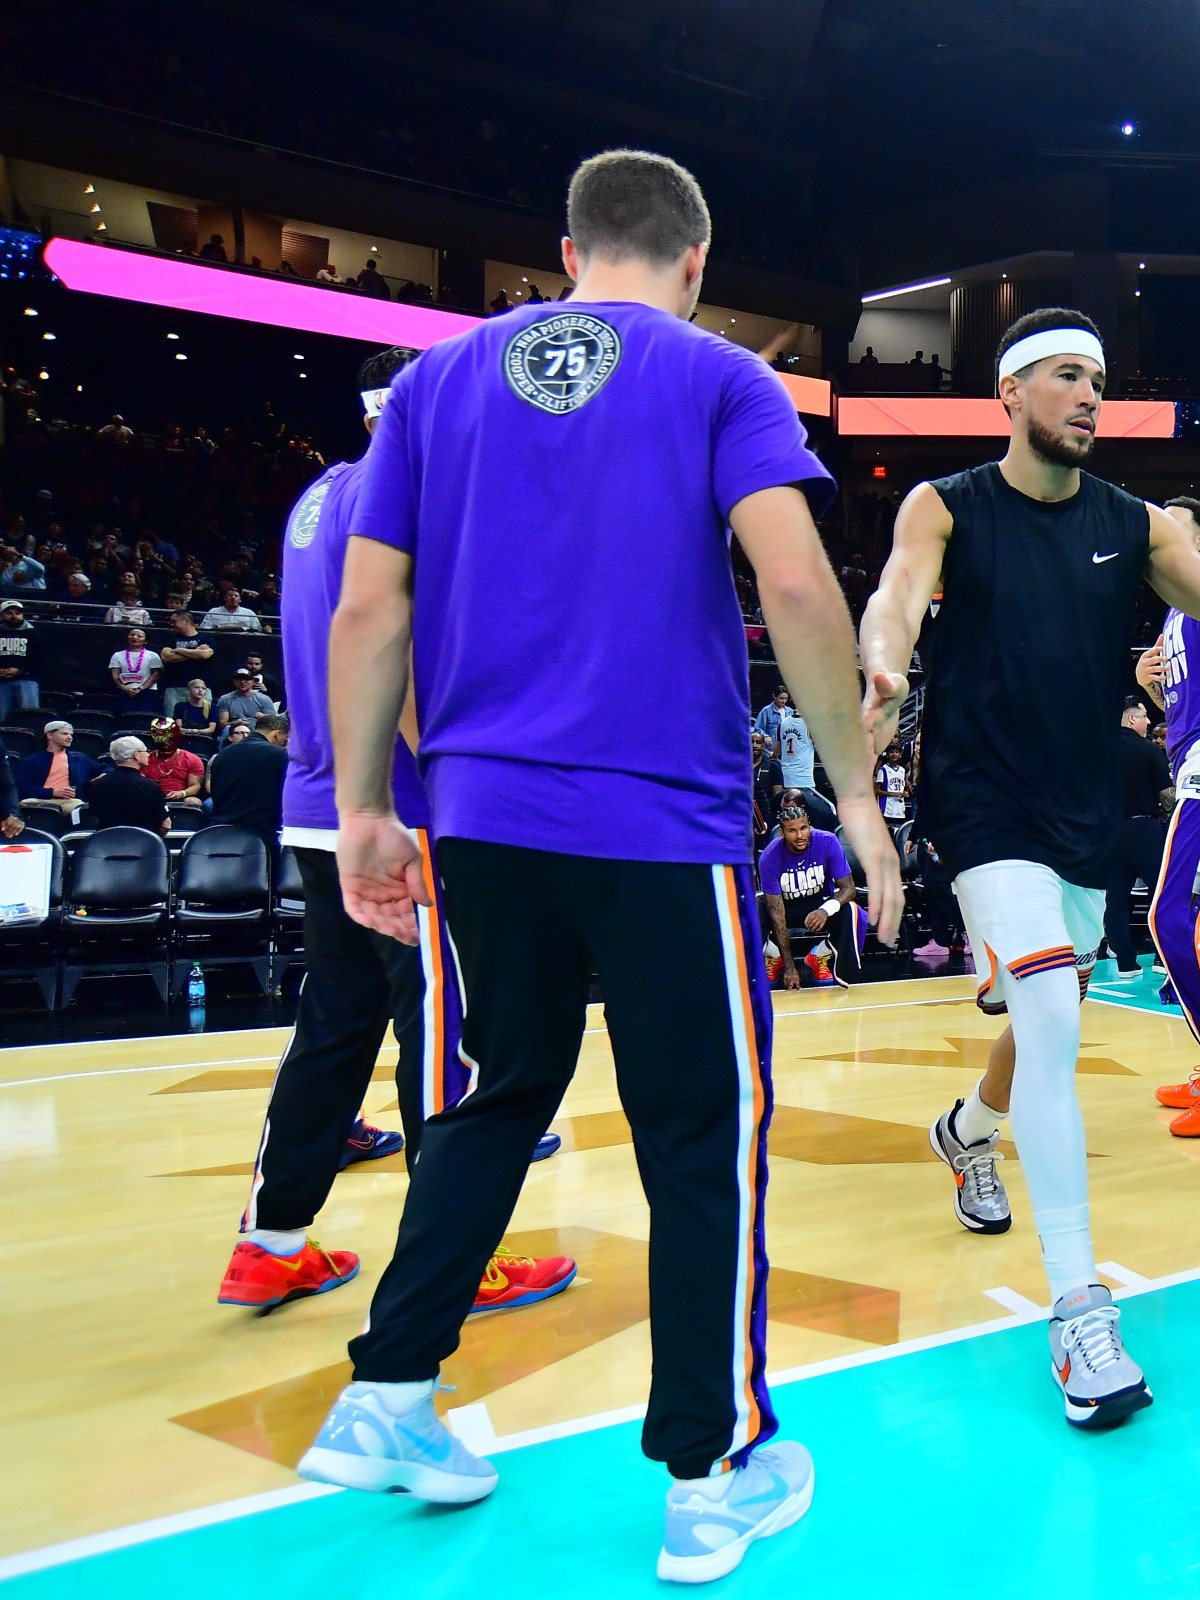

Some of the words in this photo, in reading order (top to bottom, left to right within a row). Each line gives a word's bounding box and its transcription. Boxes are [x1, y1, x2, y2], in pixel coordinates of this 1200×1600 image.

[516, 330, 541, 348] NBA
[541, 318, 602, 335] PIONEERS
[544, 345, 586, 377] 75
[510, 352, 535, 395] COOPER
[537, 389, 588, 410] CLIFTON
[590, 353, 615, 385] LLOYD
[0, 637, 28, 652] PURS
[786, 738, 795, 754] 1
[780, 864, 825, 893] BLACK
